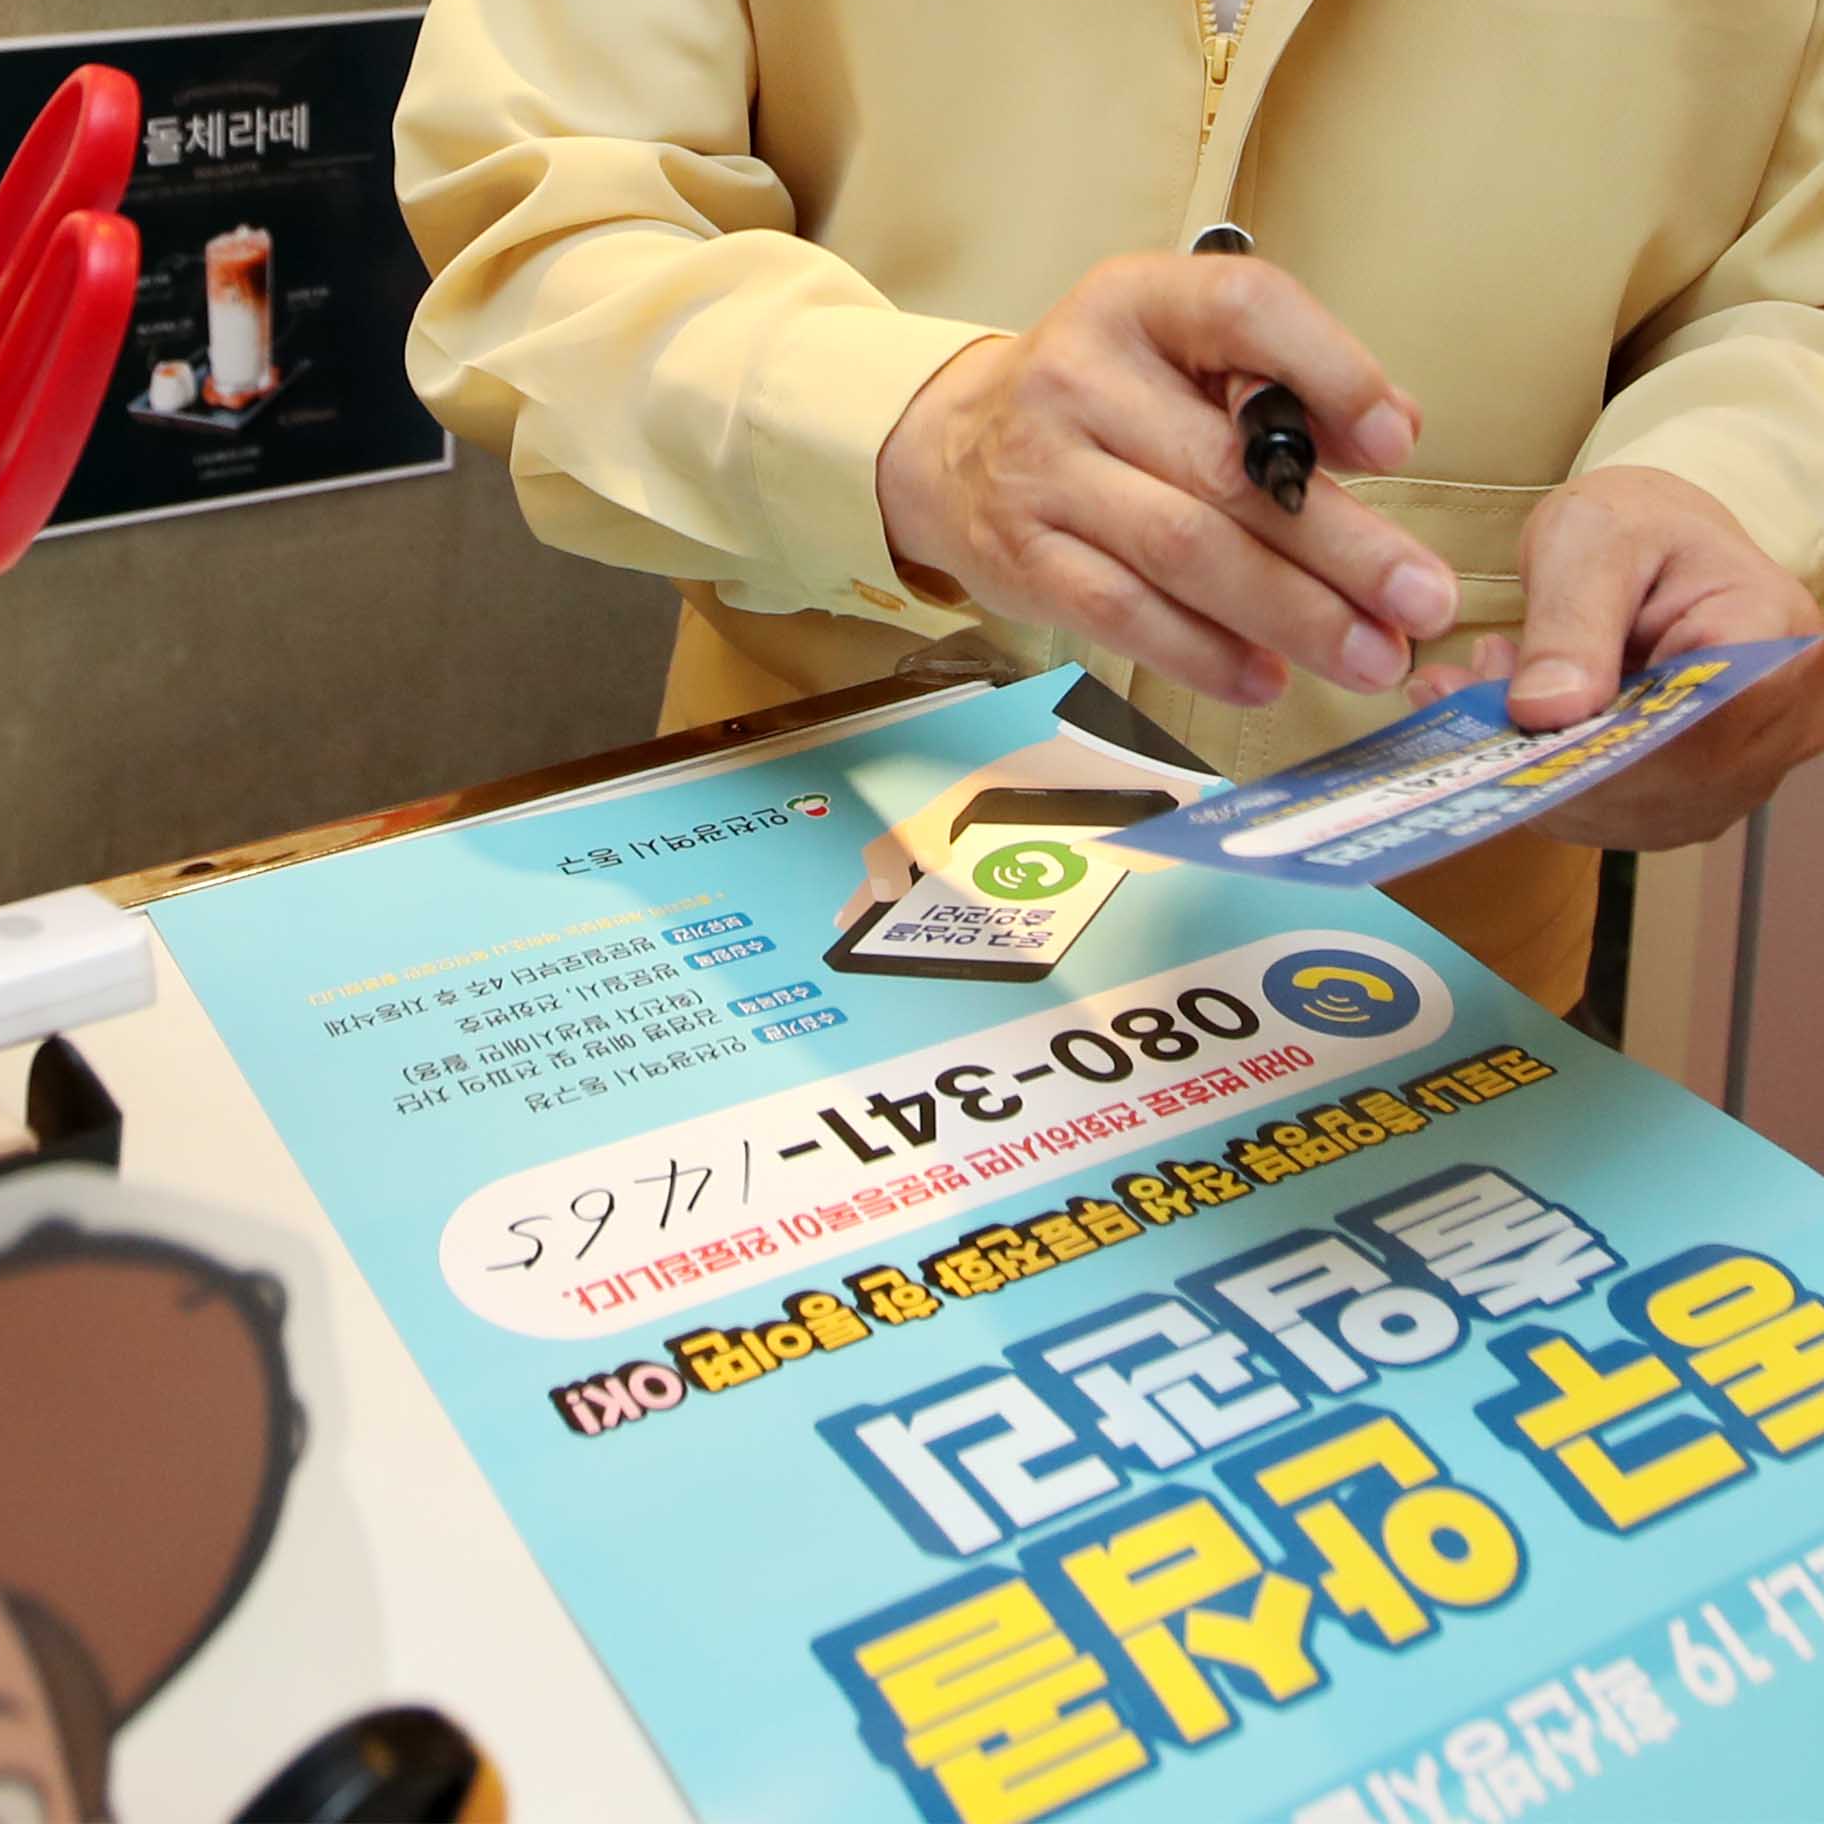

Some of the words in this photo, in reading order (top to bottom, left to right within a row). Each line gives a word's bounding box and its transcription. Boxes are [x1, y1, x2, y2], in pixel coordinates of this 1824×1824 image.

[143, 102, 311, 167] 돌체라떼
[626, 804, 789, 860] 인천광역시
[554, 843, 624, 877] 동구
[670, 913, 745, 943] 보유기간
[987, 929, 1054, 949] 동구
[509, 934, 657, 986] 방문일로부터
[691, 939, 765, 969] 수집항목
[430, 986, 459, 1009] 후
[462, 973, 504, 997] 4주
[566, 959, 680, 1001] 방문일시,
[734, 983, 811, 1016] 수집목적
[320, 995, 429, 1038] 자동삭제
[453, 994, 563, 1036] 전화번호
[613, 988, 704, 1024] (확진자
[639, 1008, 723, 1044] 감염병
[759, 1009, 839, 1043] 수집기관
[475, 1016, 607, 1065] 발생시에만
[546, 1047, 576, 1071] 및
[581, 1030, 637, 1060] 예방
[612, 1036, 748, 1088] 인천광역시
[1245, 1043, 1316, 1077] 아래
[397, 1053, 469, 1088] 활용)
[455, 1059, 540, 1098] 전파의
[1138, 1064, 1250, 1118] 번호로
[1408, 1046, 1555, 1116] 코로나
[391, 1081, 450, 1116] 차단
[521, 1074, 608, 1113] 동구청
[963, 1102, 1146, 1175] 전화하시면
[1236, 1090, 1432, 1179] 출입명부
[776, 1162, 972, 1247] 방문등록이
[1124, 1164, 1249, 1225] 작성
[930, 1198, 1147, 1298] 무료전화
[560, 1224, 780, 1318] 완료됩니다.
[857, 1266, 943, 1326] 한
[679, 1292, 872, 1394] 통이면
[854, 1167, 1616, 1556] 출입관리
[564, 1363, 685, 1437] OK!
[852, 1414, 1520, 1824] 안심콜
[1670, 1602, 1764, 1708] 19
